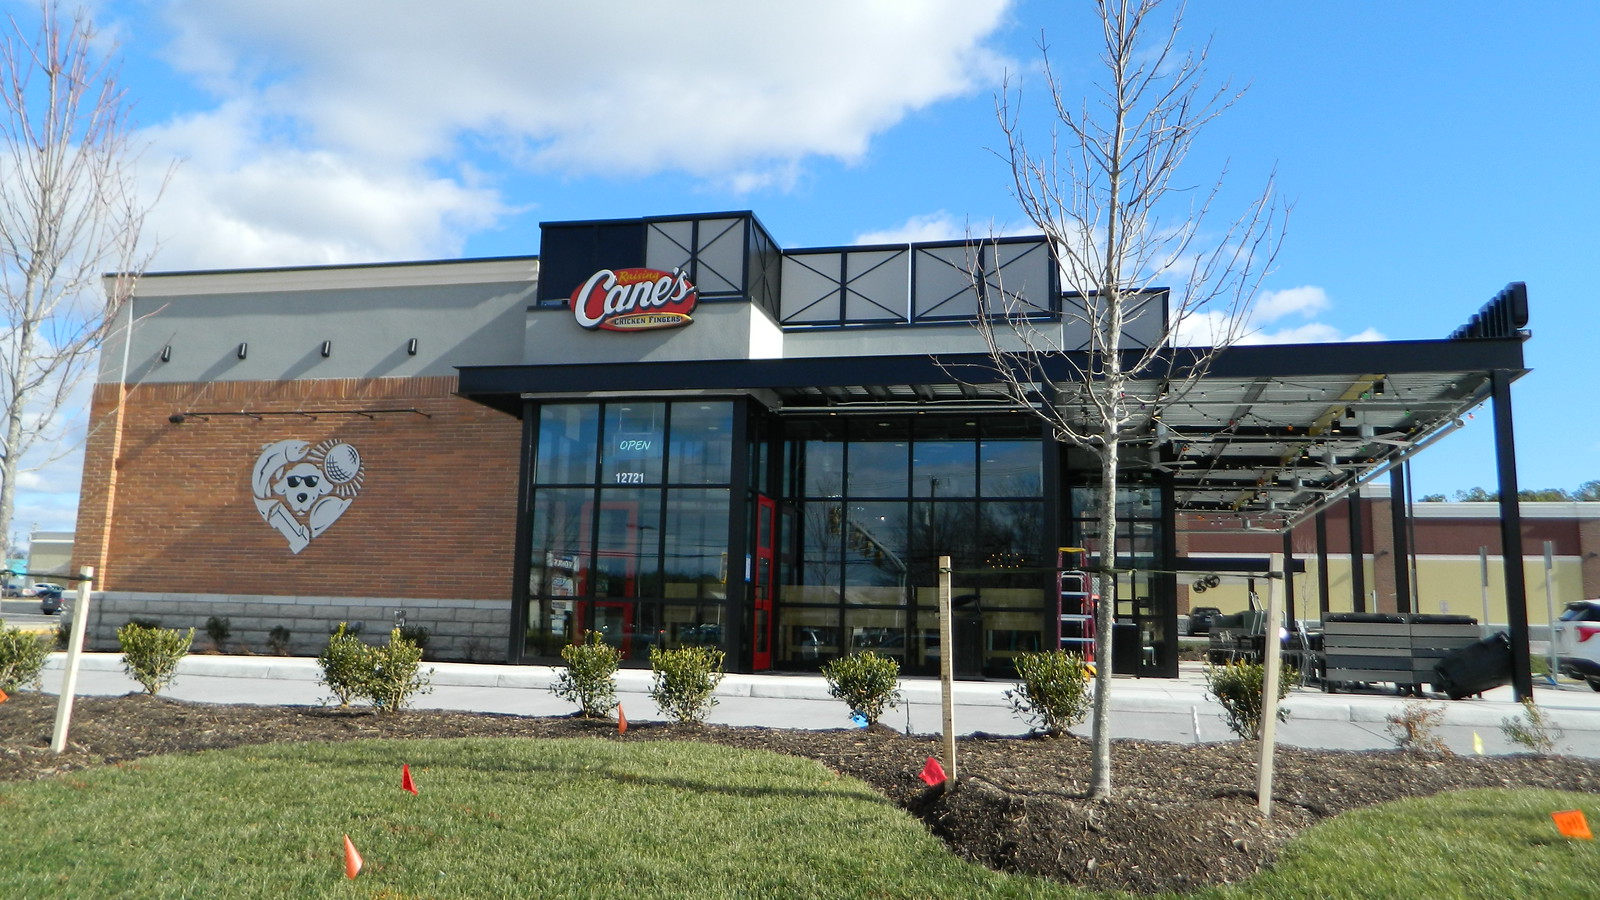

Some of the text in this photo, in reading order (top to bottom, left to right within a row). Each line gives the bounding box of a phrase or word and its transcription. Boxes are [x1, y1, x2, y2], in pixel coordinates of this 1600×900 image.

[618, 270, 660, 283] Raising
[574, 266, 696, 328] Cane's
[614, 315, 681, 326] CHICKEN FINGERS
[620, 440, 651, 450] OPEN
[615, 472, 644, 483] 12721
